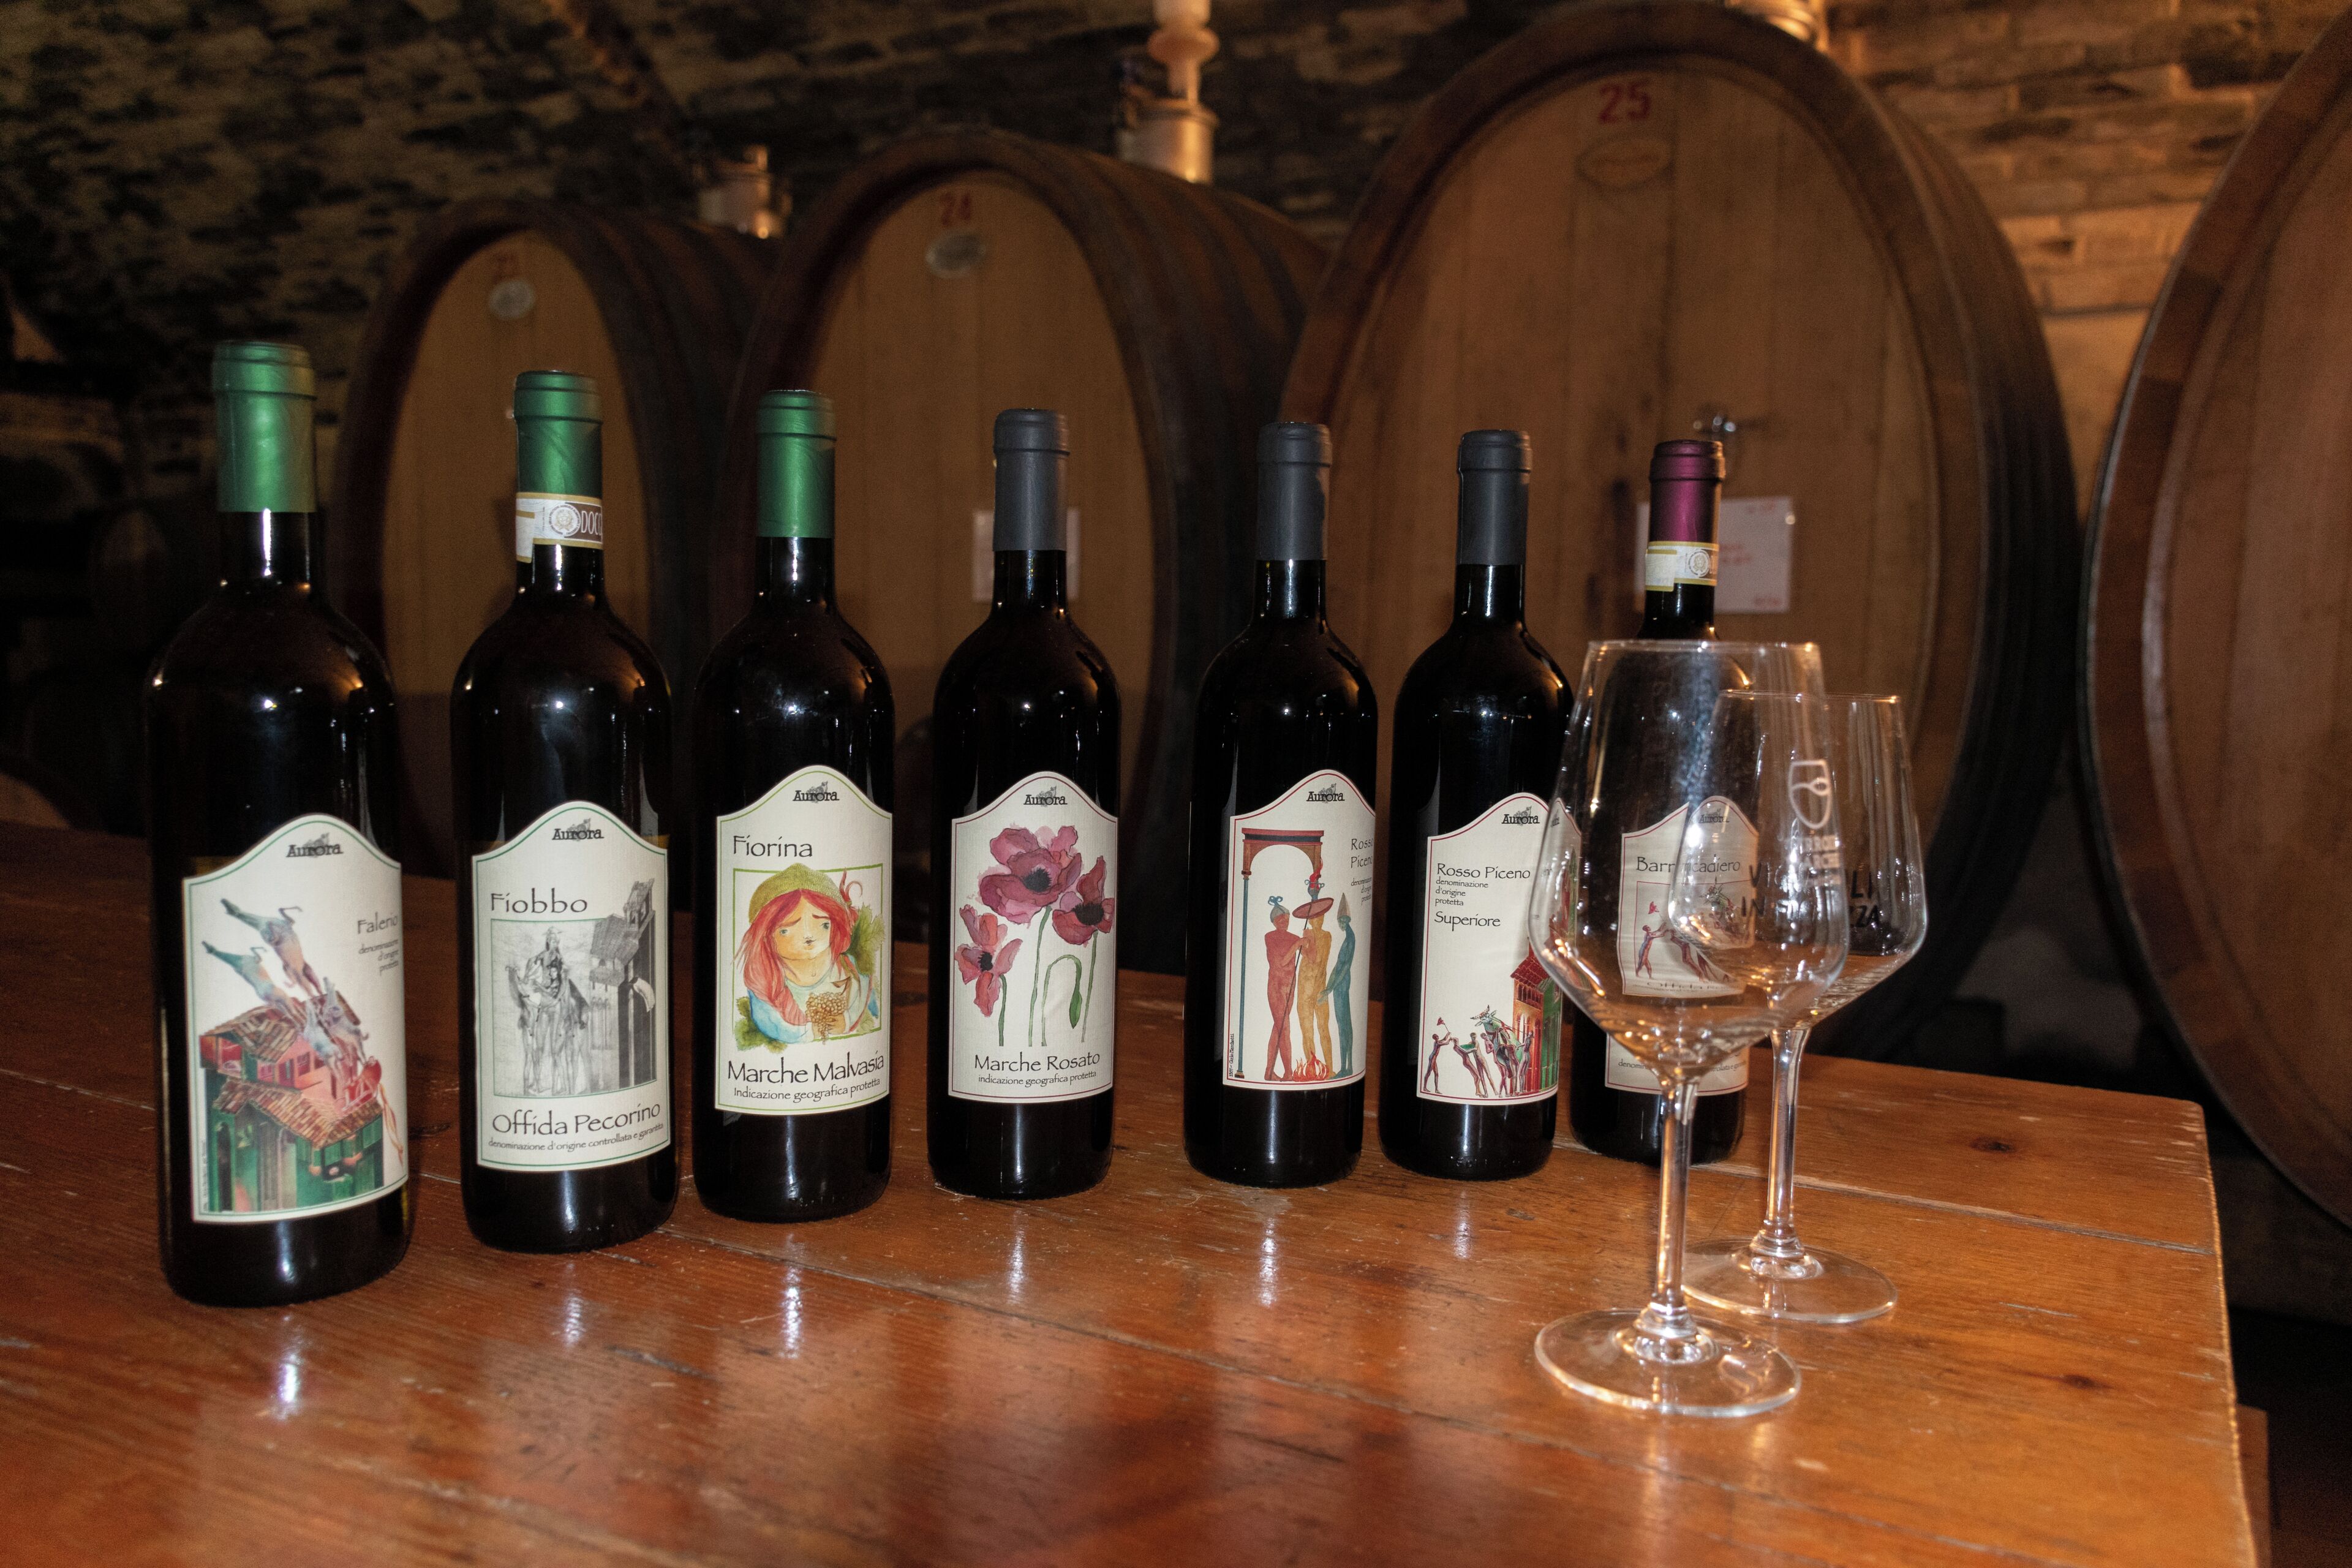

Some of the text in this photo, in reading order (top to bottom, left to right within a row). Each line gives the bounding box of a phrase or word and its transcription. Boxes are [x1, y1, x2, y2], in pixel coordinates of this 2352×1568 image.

[1598, 77, 1652, 123] 25
[793, 790, 840, 801] Aurora
[1023, 794, 1068, 805] Aurora
[1306, 791, 1345, 802] Aurora
[1501, 814, 1540, 824] Aurora
[552, 828, 604, 840] Aurora
[286, 844, 344, 858] Aurora
[733, 835, 813, 858] Fiorina
[1437, 863, 1530, 879] Rosso Piceno
[1436, 876, 1488, 888] denominazione
[491, 888, 587, 913] Fiobbo
[1435, 886, 1466, 899] d'origine
[1435, 898, 1464, 907] protetta
[1434, 911, 1501, 932] Superiore
[728, 1050, 884, 1084] Marche Malvasia
[974, 1052, 1100, 1072] Marche Rosato
[1618, 1059, 1646, 1069] denomin
[979, 1071, 1096, 1088] indicazione geografica protetta
[734, 1077, 880, 1103] Indicazione geografica protetta
[492, 1102, 660, 1135] Offida Pecorino
[488, 1137, 545, 1151] denominazione
[548, 1140, 586, 1152] d'origine
[588, 1133, 632, 1147] controllata
[639, 1122, 664, 1140] garantita
